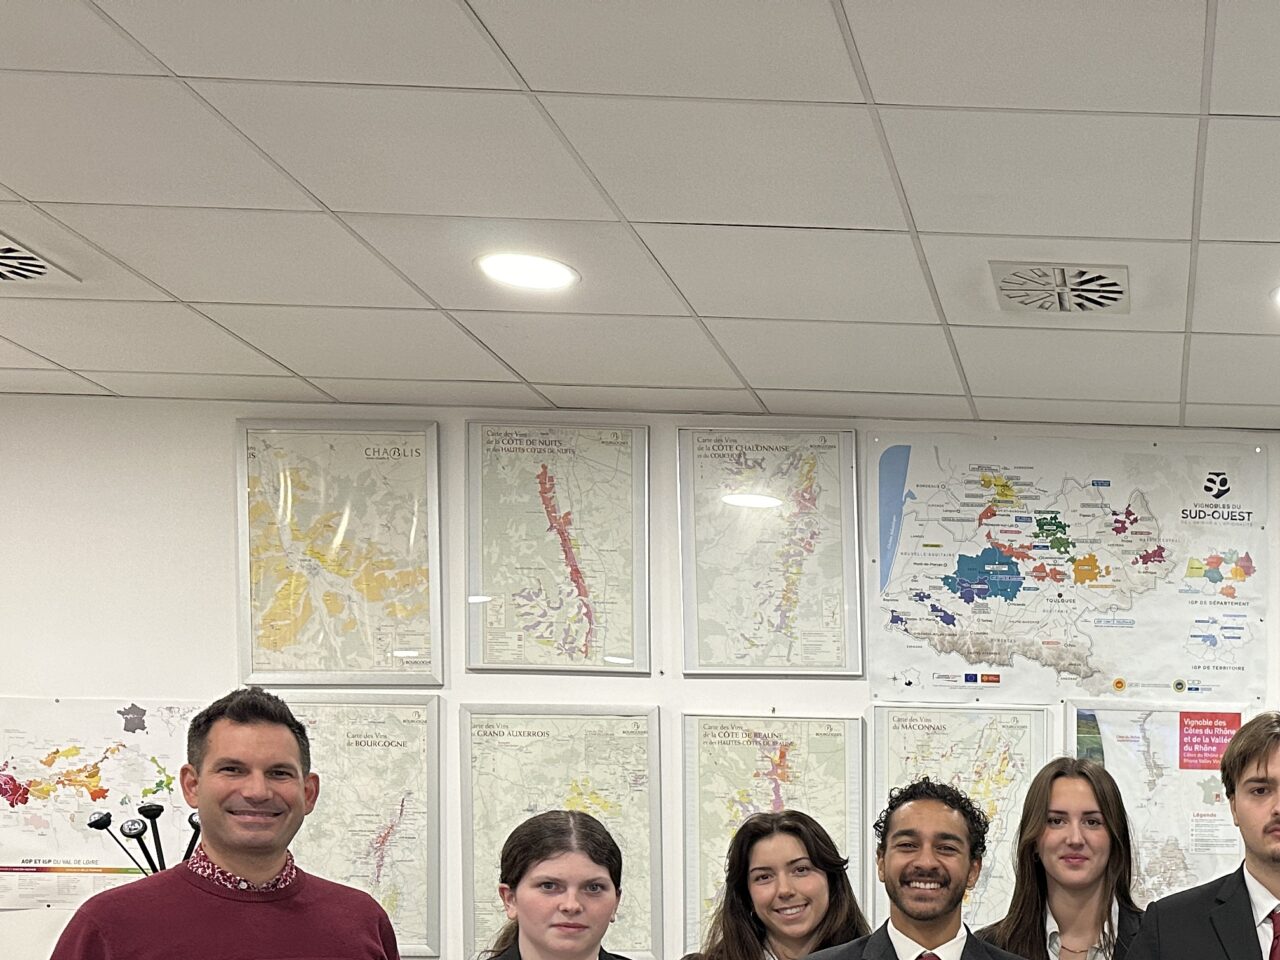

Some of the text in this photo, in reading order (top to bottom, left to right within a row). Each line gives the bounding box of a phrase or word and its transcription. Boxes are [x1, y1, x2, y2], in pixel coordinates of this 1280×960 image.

[501, 437, 524, 446] CÔTE
[539, 439, 563, 447] NUITS
[556, 448, 576, 456] NUITS
[712, 443, 733, 452] CÔTE
[735, 444, 789, 452] CHALONNAISE
[364, 447, 421, 460] CHABLIS
[1193, 502, 1231, 510] VIGNOBLES
[1181, 508, 1254, 522] SUD-OUEST
[901, 723, 947, 731] MÂCONNAIS
[1184, 718, 1226, 727] Vignoble des
[507, 730, 550, 738] AUXERROIS
[717, 730, 740, 739] CÔTE
[741, 731, 752, 739] DE
[753, 731, 784, 739] BEAUNE
[1184, 727, 1203, 735] Côtes
[1214, 728, 1236, 736] Rhône
[1194, 744, 1217, 752] Rhône
